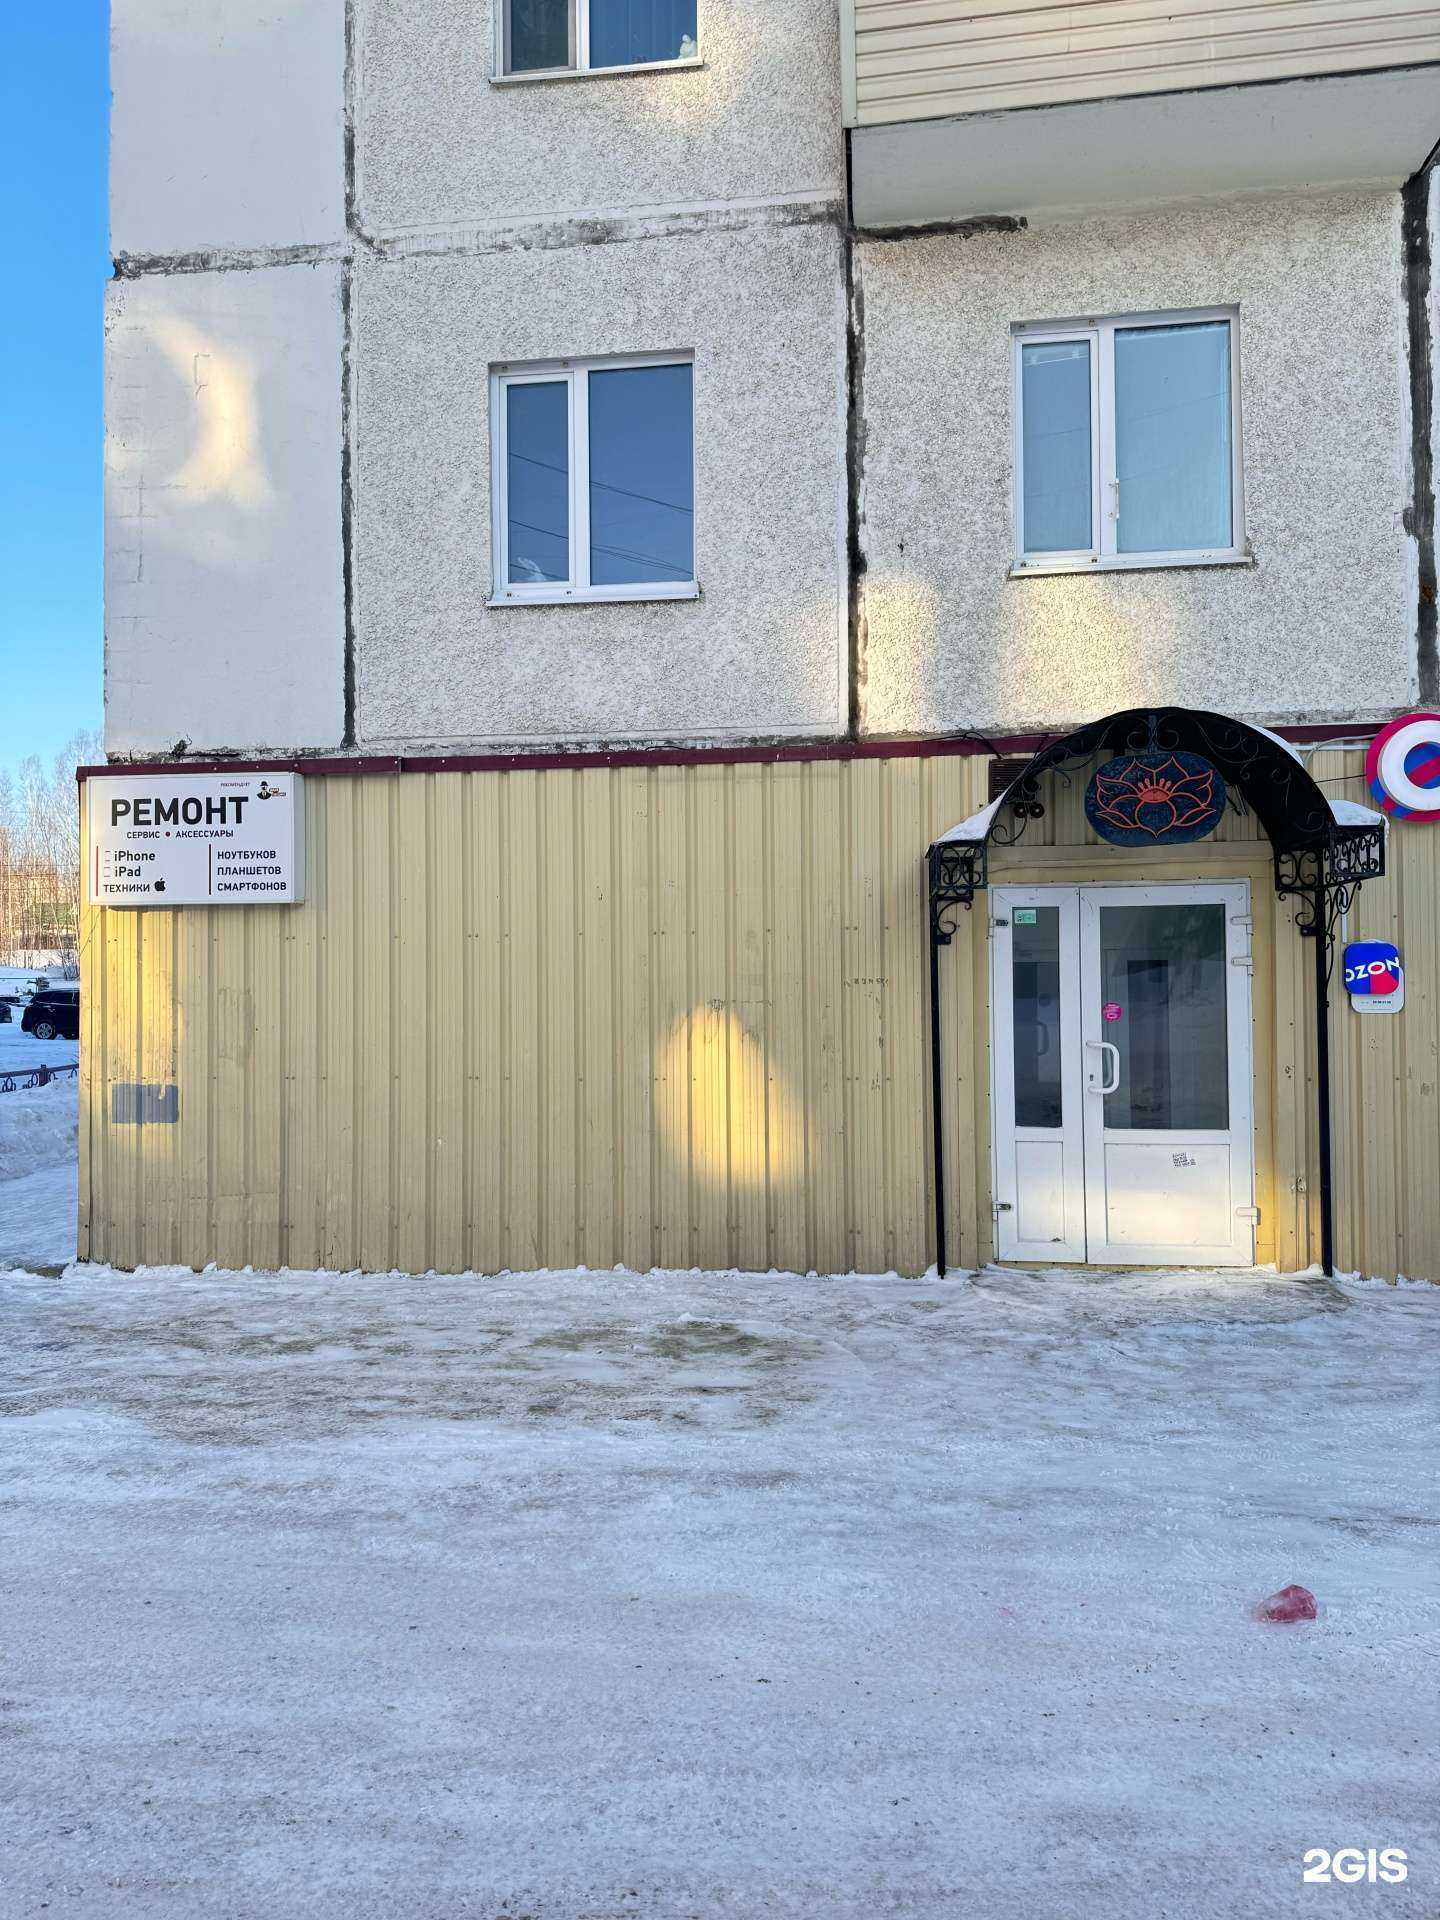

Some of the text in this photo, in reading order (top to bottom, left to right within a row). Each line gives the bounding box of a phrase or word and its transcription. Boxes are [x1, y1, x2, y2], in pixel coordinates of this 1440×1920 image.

[111, 796, 249, 826] РЕМОНТ
[126, 830, 234, 839] СЕРВИС АКСЕССУАРЫ
[114, 850, 156, 862] iPhone
[217, 850, 277, 860] НОУТБУКОВ
[114, 866, 142, 877] iPad
[217, 866, 282, 876] ПЛАНШЕТОВ
[103, 884, 151, 893] ТЕХНИКИ
[217, 882, 287, 892] СМАРТФОНОВ
[1345, 957, 1400, 982] OZON
